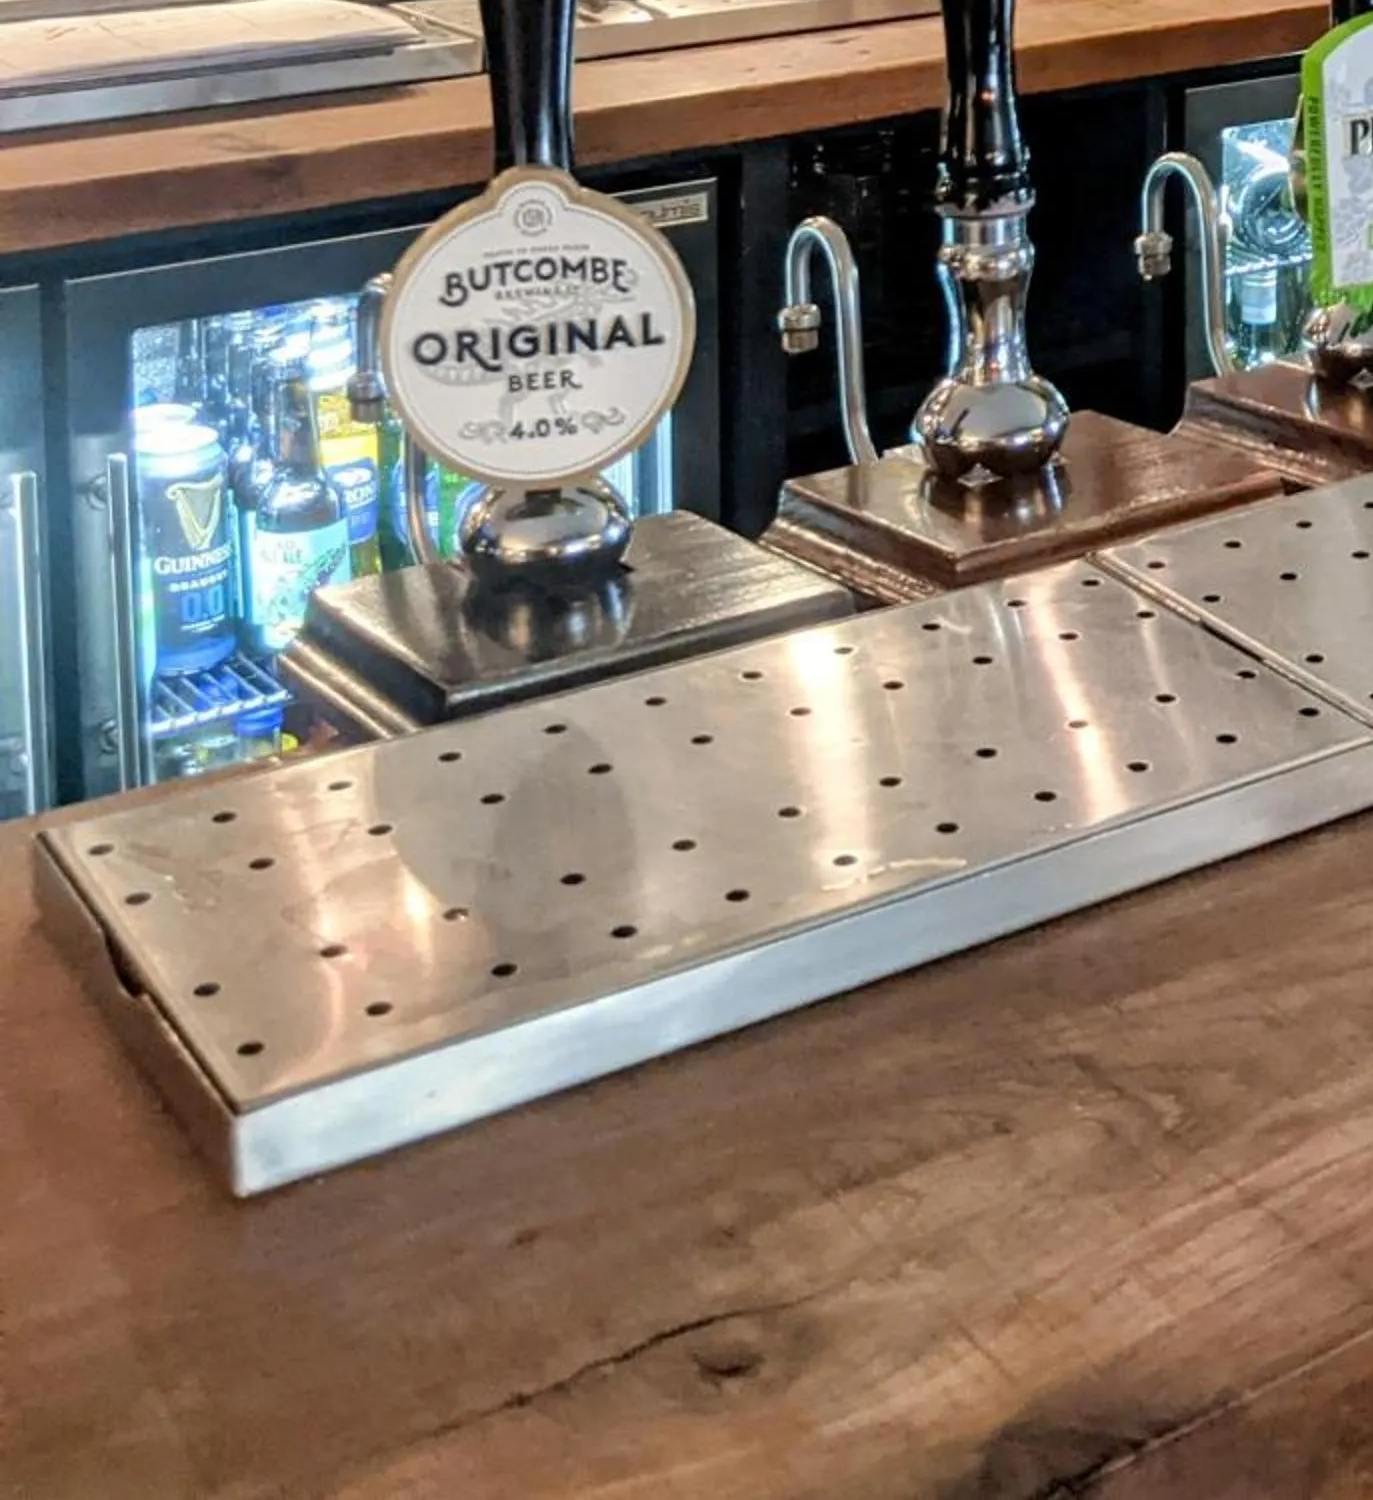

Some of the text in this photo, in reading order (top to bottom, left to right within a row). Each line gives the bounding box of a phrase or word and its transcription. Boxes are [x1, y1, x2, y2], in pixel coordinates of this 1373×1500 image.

[438, 256, 630, 307] BUTCOMBE
[412, 312, 665, 372] ORIGINAL
[508, 370, 583, 393] BEER
[509, 417, 578, 439] 4.0%
[182, 583, 224, 622] 0.0
